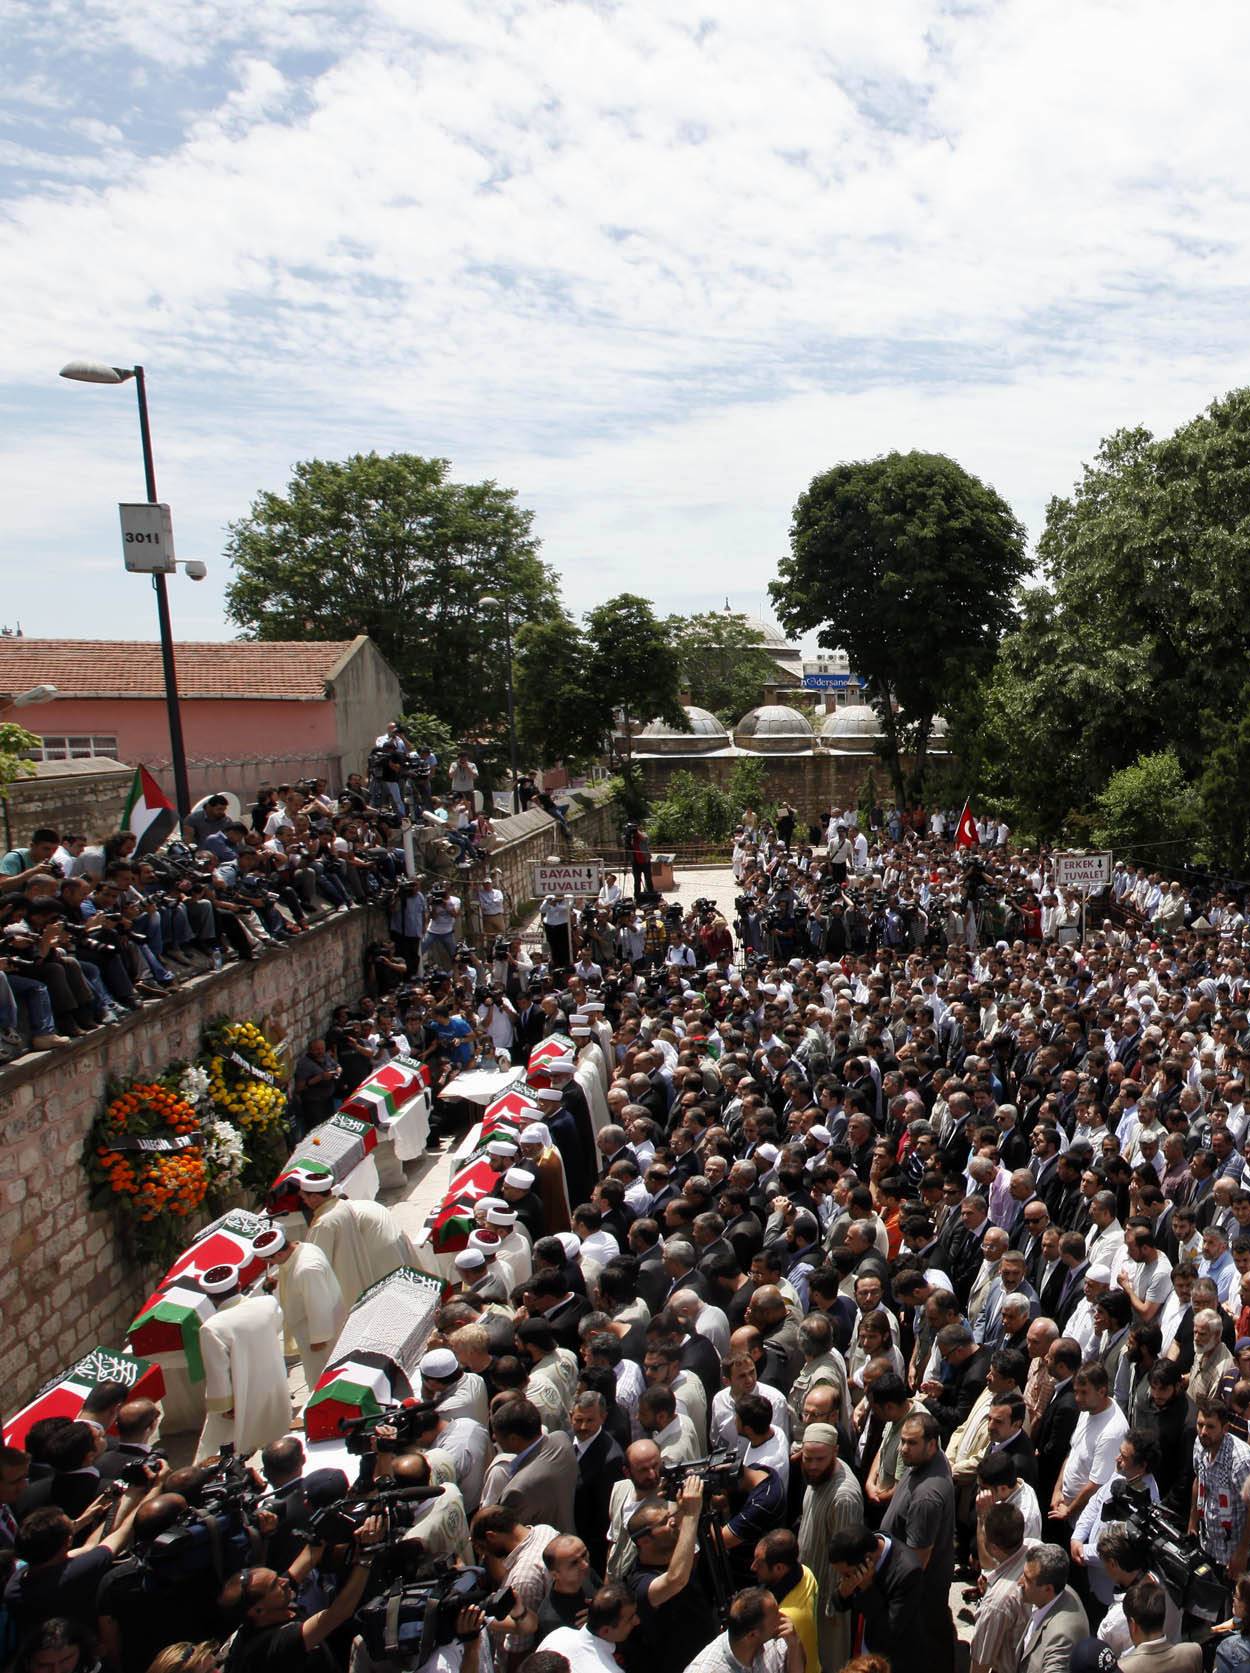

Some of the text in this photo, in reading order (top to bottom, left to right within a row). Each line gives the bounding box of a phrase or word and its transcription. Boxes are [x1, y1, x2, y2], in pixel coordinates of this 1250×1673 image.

[125, 532, 160, 545] 3011
[1064, 859, 1095, 870] ERKEK
[539, 868, 583, 879] BAYAN
[1064, 870, 1105, 881] TUVALET
[540, 880, 593, 892] TUVALET
